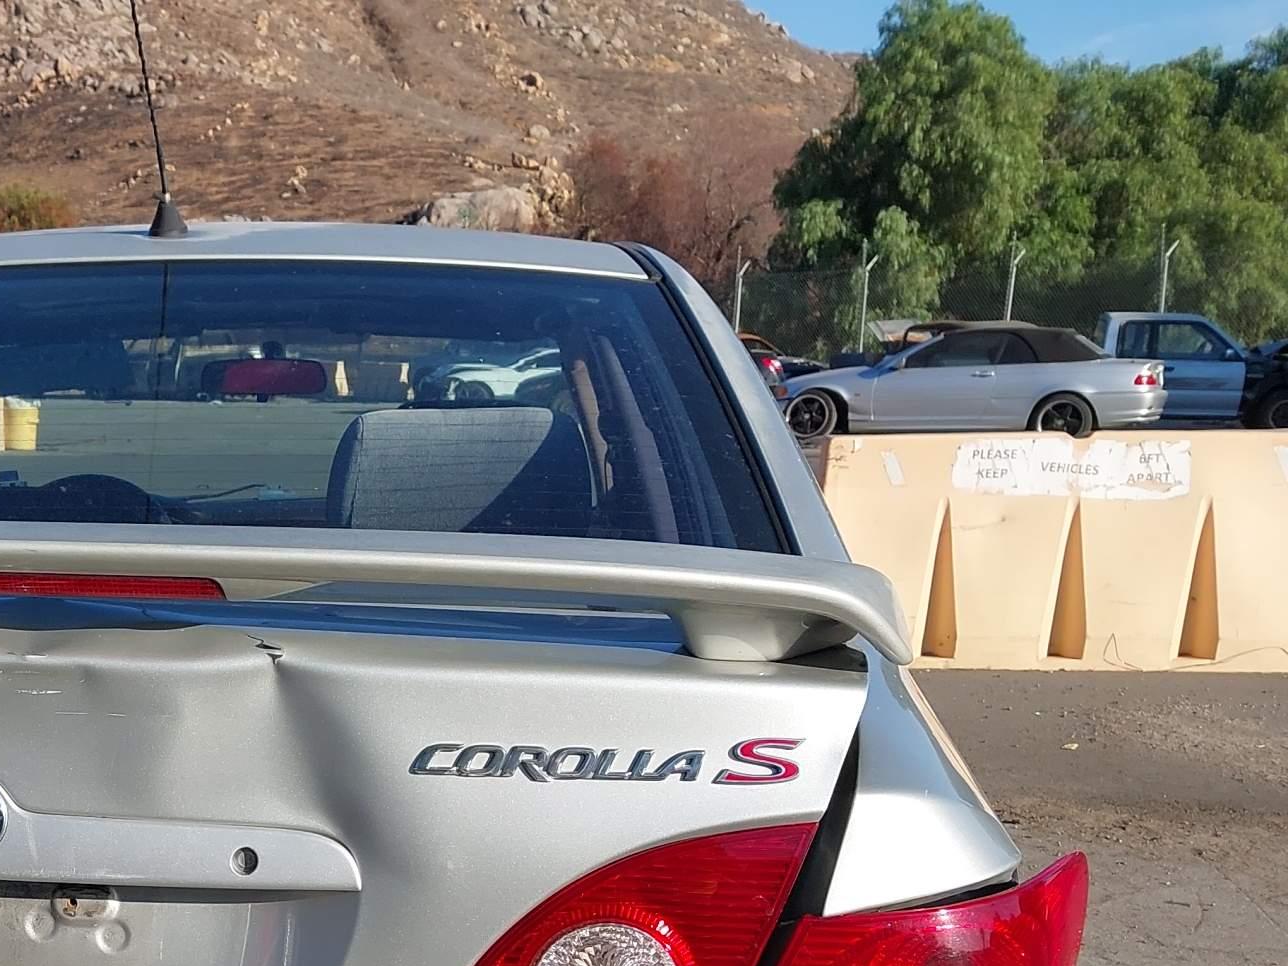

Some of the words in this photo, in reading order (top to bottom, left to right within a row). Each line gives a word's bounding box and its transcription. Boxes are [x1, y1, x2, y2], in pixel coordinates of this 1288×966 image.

[972, 448, 1018, 460] PLEASE
[976, 468, 1009, 479] KEEP
[1040, 461, 1100, 476] VEHICLES
[1126, 472, 1172, 484] APART
[408, 743, 706, 783] COROLLA
[711, 737, 807, 785] S
